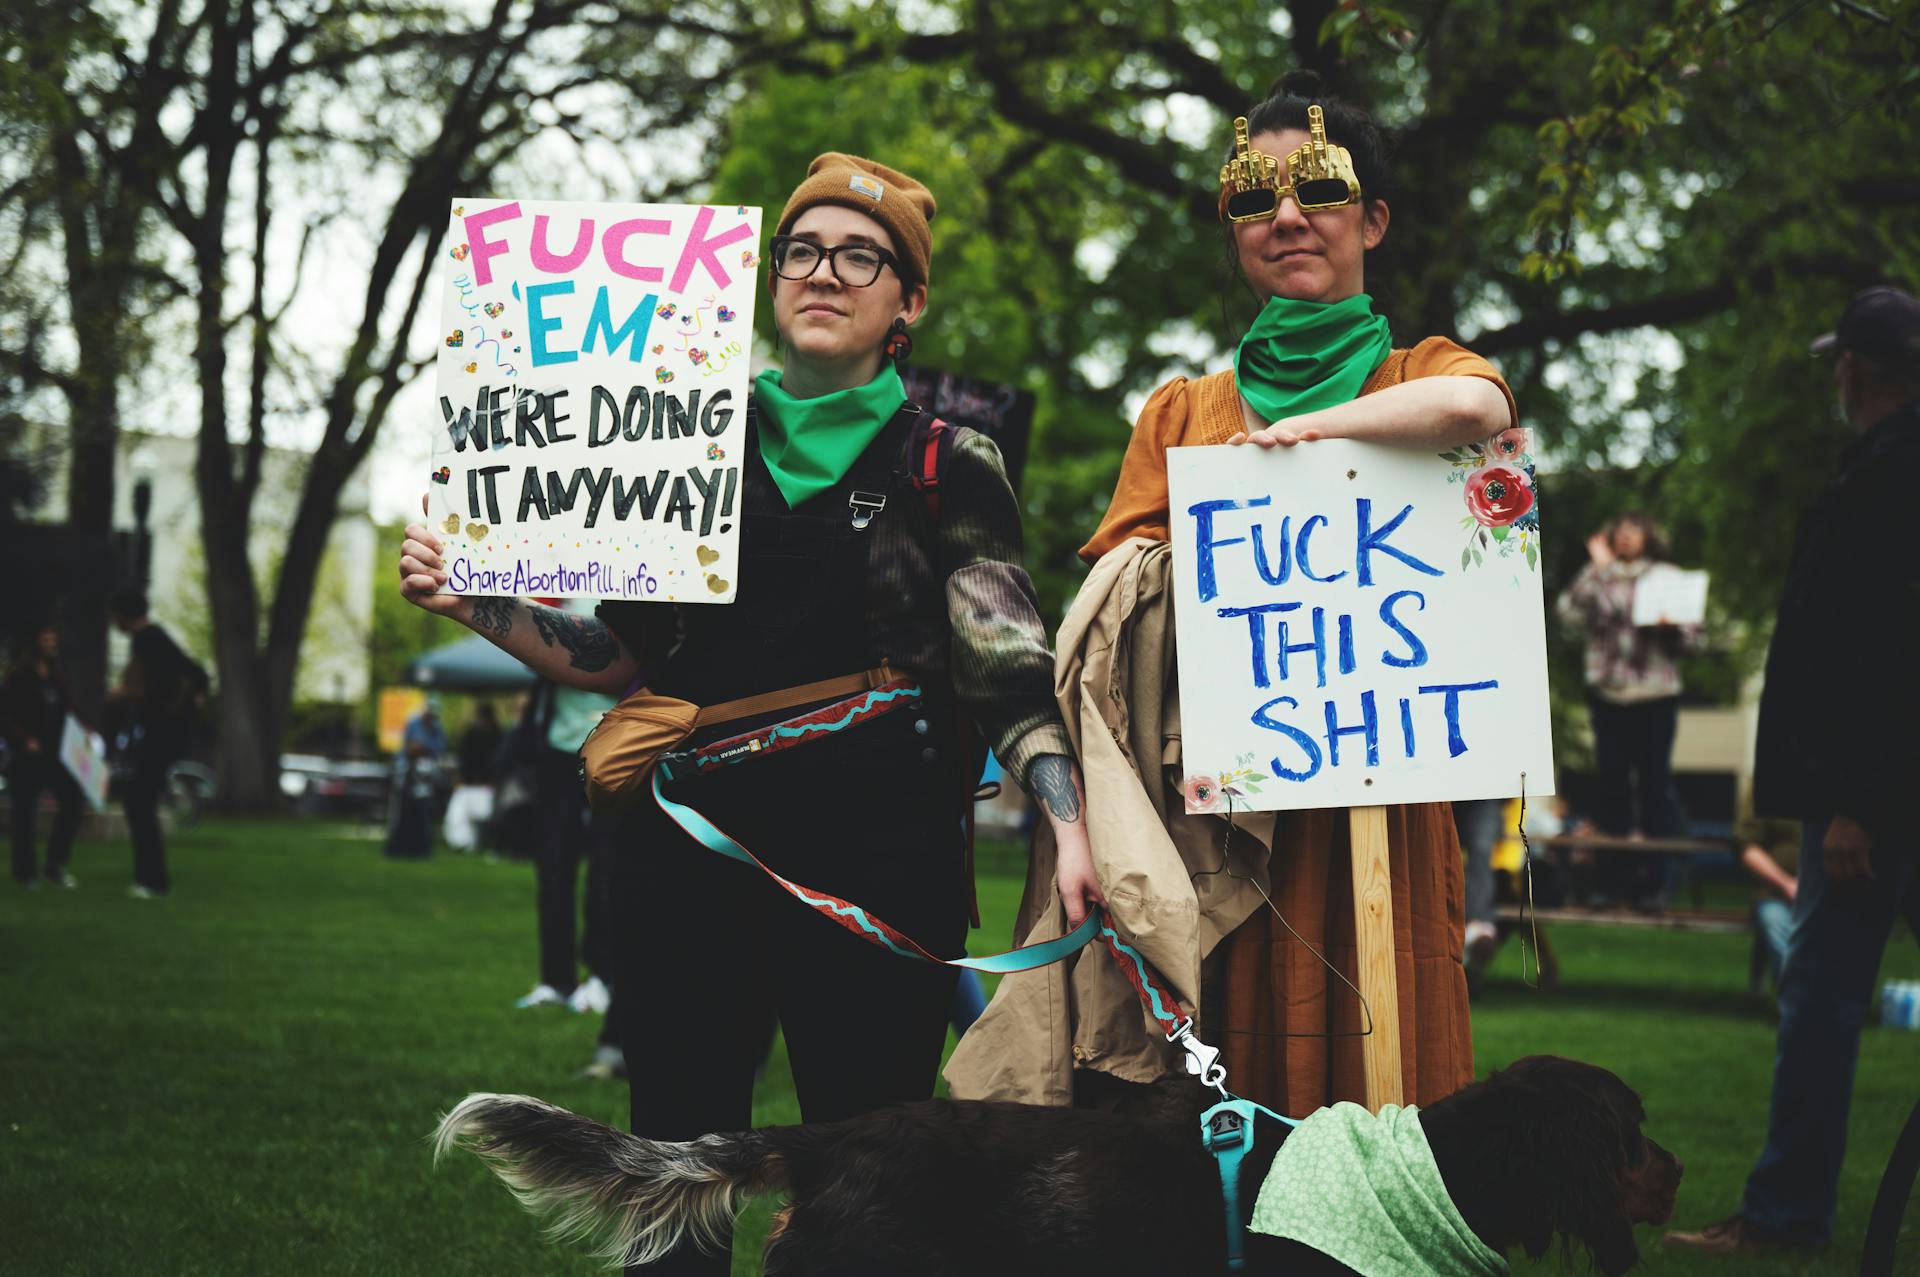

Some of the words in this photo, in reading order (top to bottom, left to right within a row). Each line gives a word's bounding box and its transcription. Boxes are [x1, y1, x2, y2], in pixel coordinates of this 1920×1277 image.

[464, 202, 754, 294] FUCK
[512, 280, 658, 368] 'EM
[440, 385, 576, 453] WE'RE
[587, 384, 734, 448] DOING
[466, 465, 510, 525] IT
[516, 465, 738, 538] ANYWAY!
[447, 557, 658, 598] ShareAbortionPill.info
[1187, 495, 1446, 604] FUCK
[1216, 590, 1429, 689] THIS
[1250, 680, 1499, 783] SHIT
